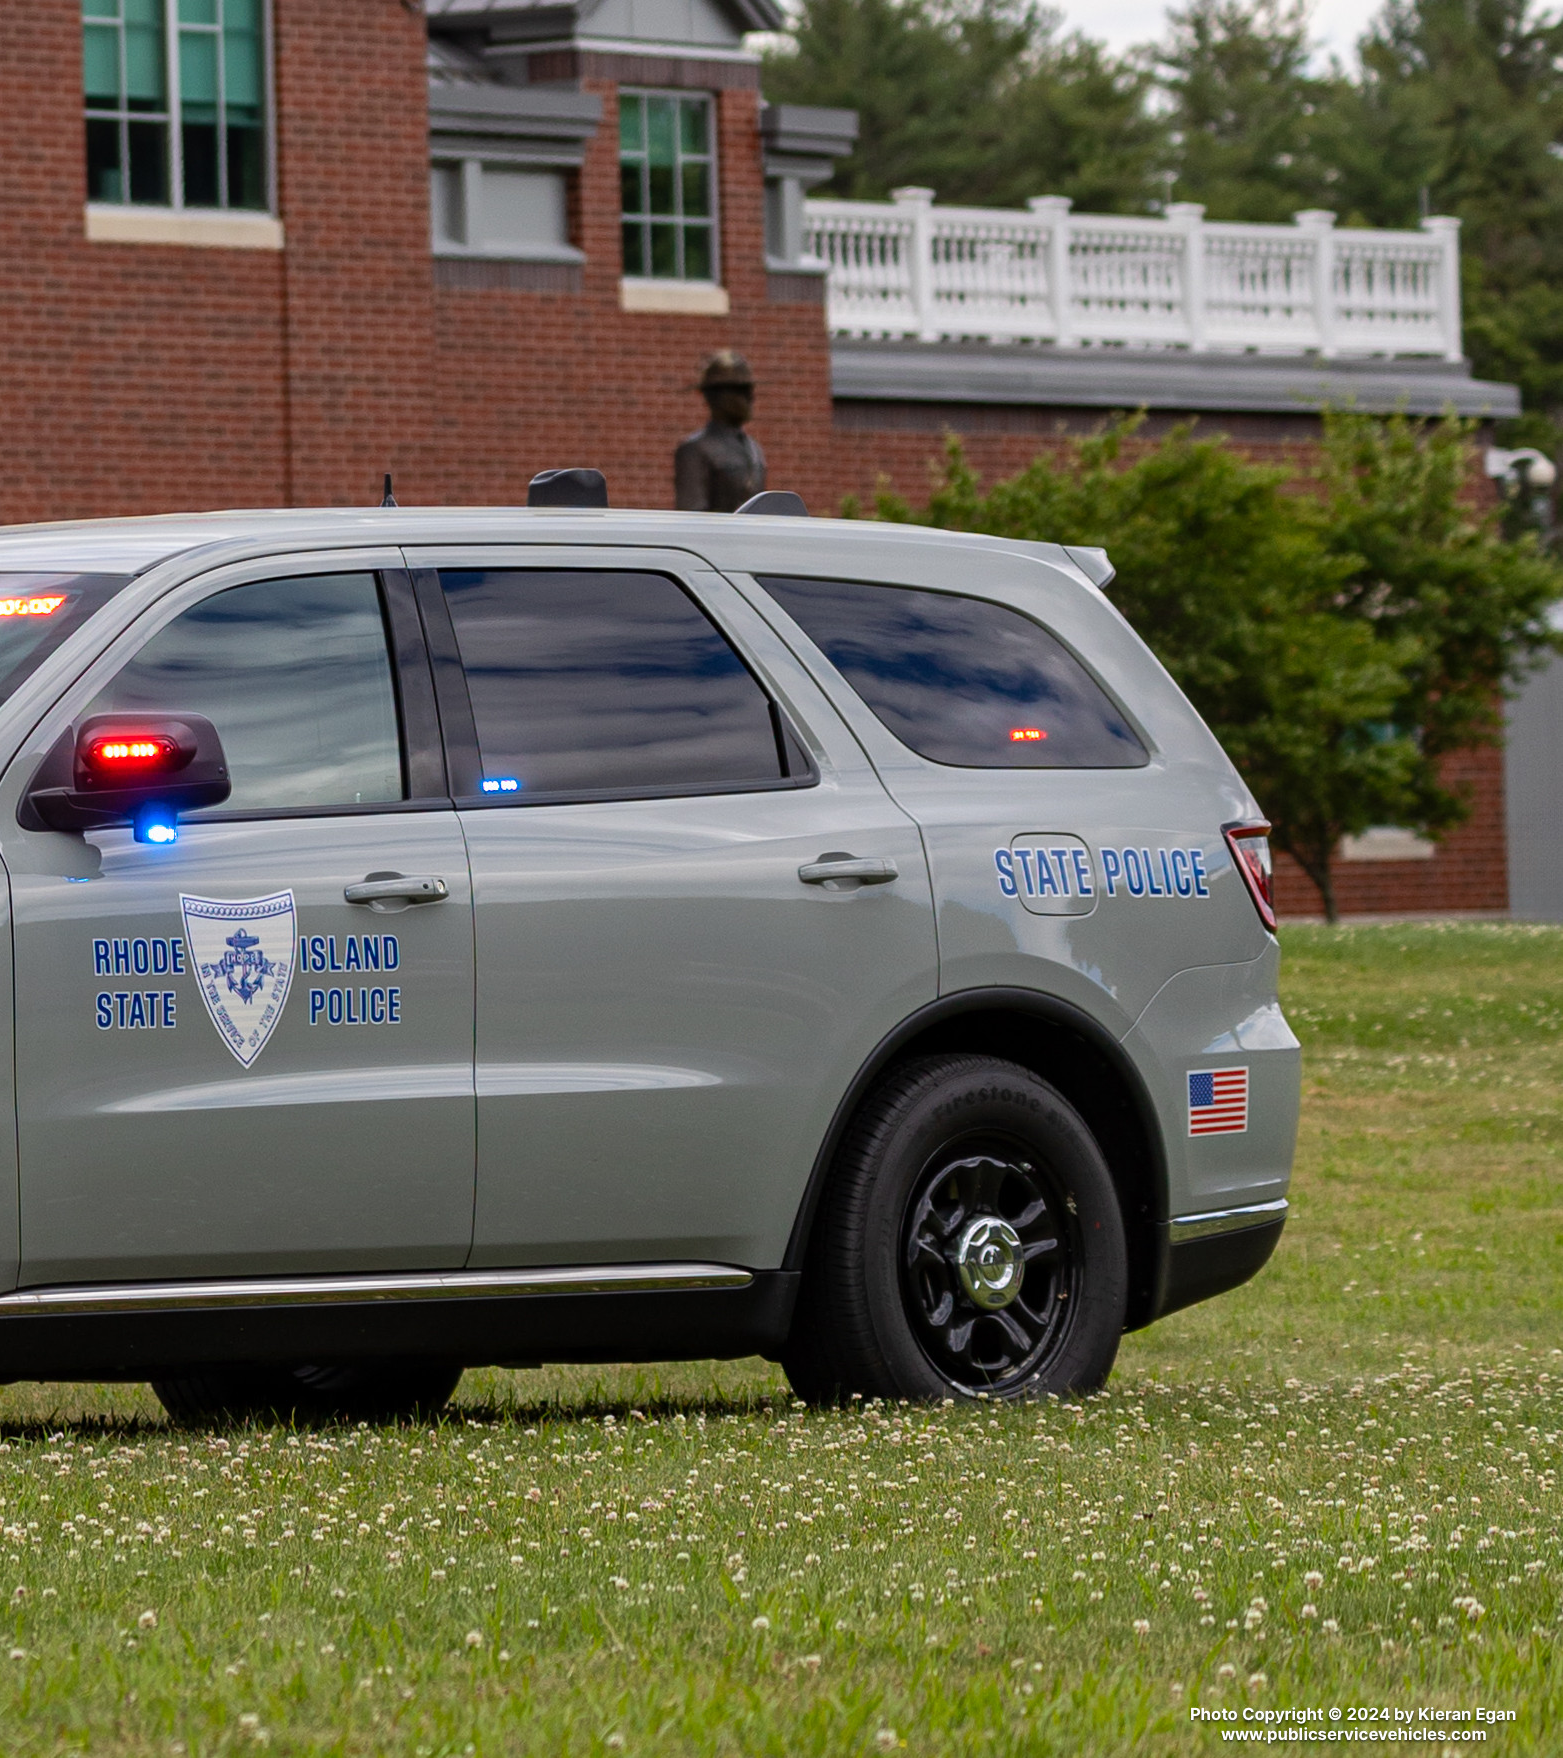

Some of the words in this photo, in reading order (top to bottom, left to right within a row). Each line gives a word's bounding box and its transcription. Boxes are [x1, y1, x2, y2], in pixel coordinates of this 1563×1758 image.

[994, 847, 1094, 898] STATE
[1099, 848, 1210, 898] POLICE
[93, 937, 186, 976] RHODE
[300, 935, 399, 973] ISLAND
[95, 991, 177, 1030] STATE
[309, 987, 401, 1025] POLICE
